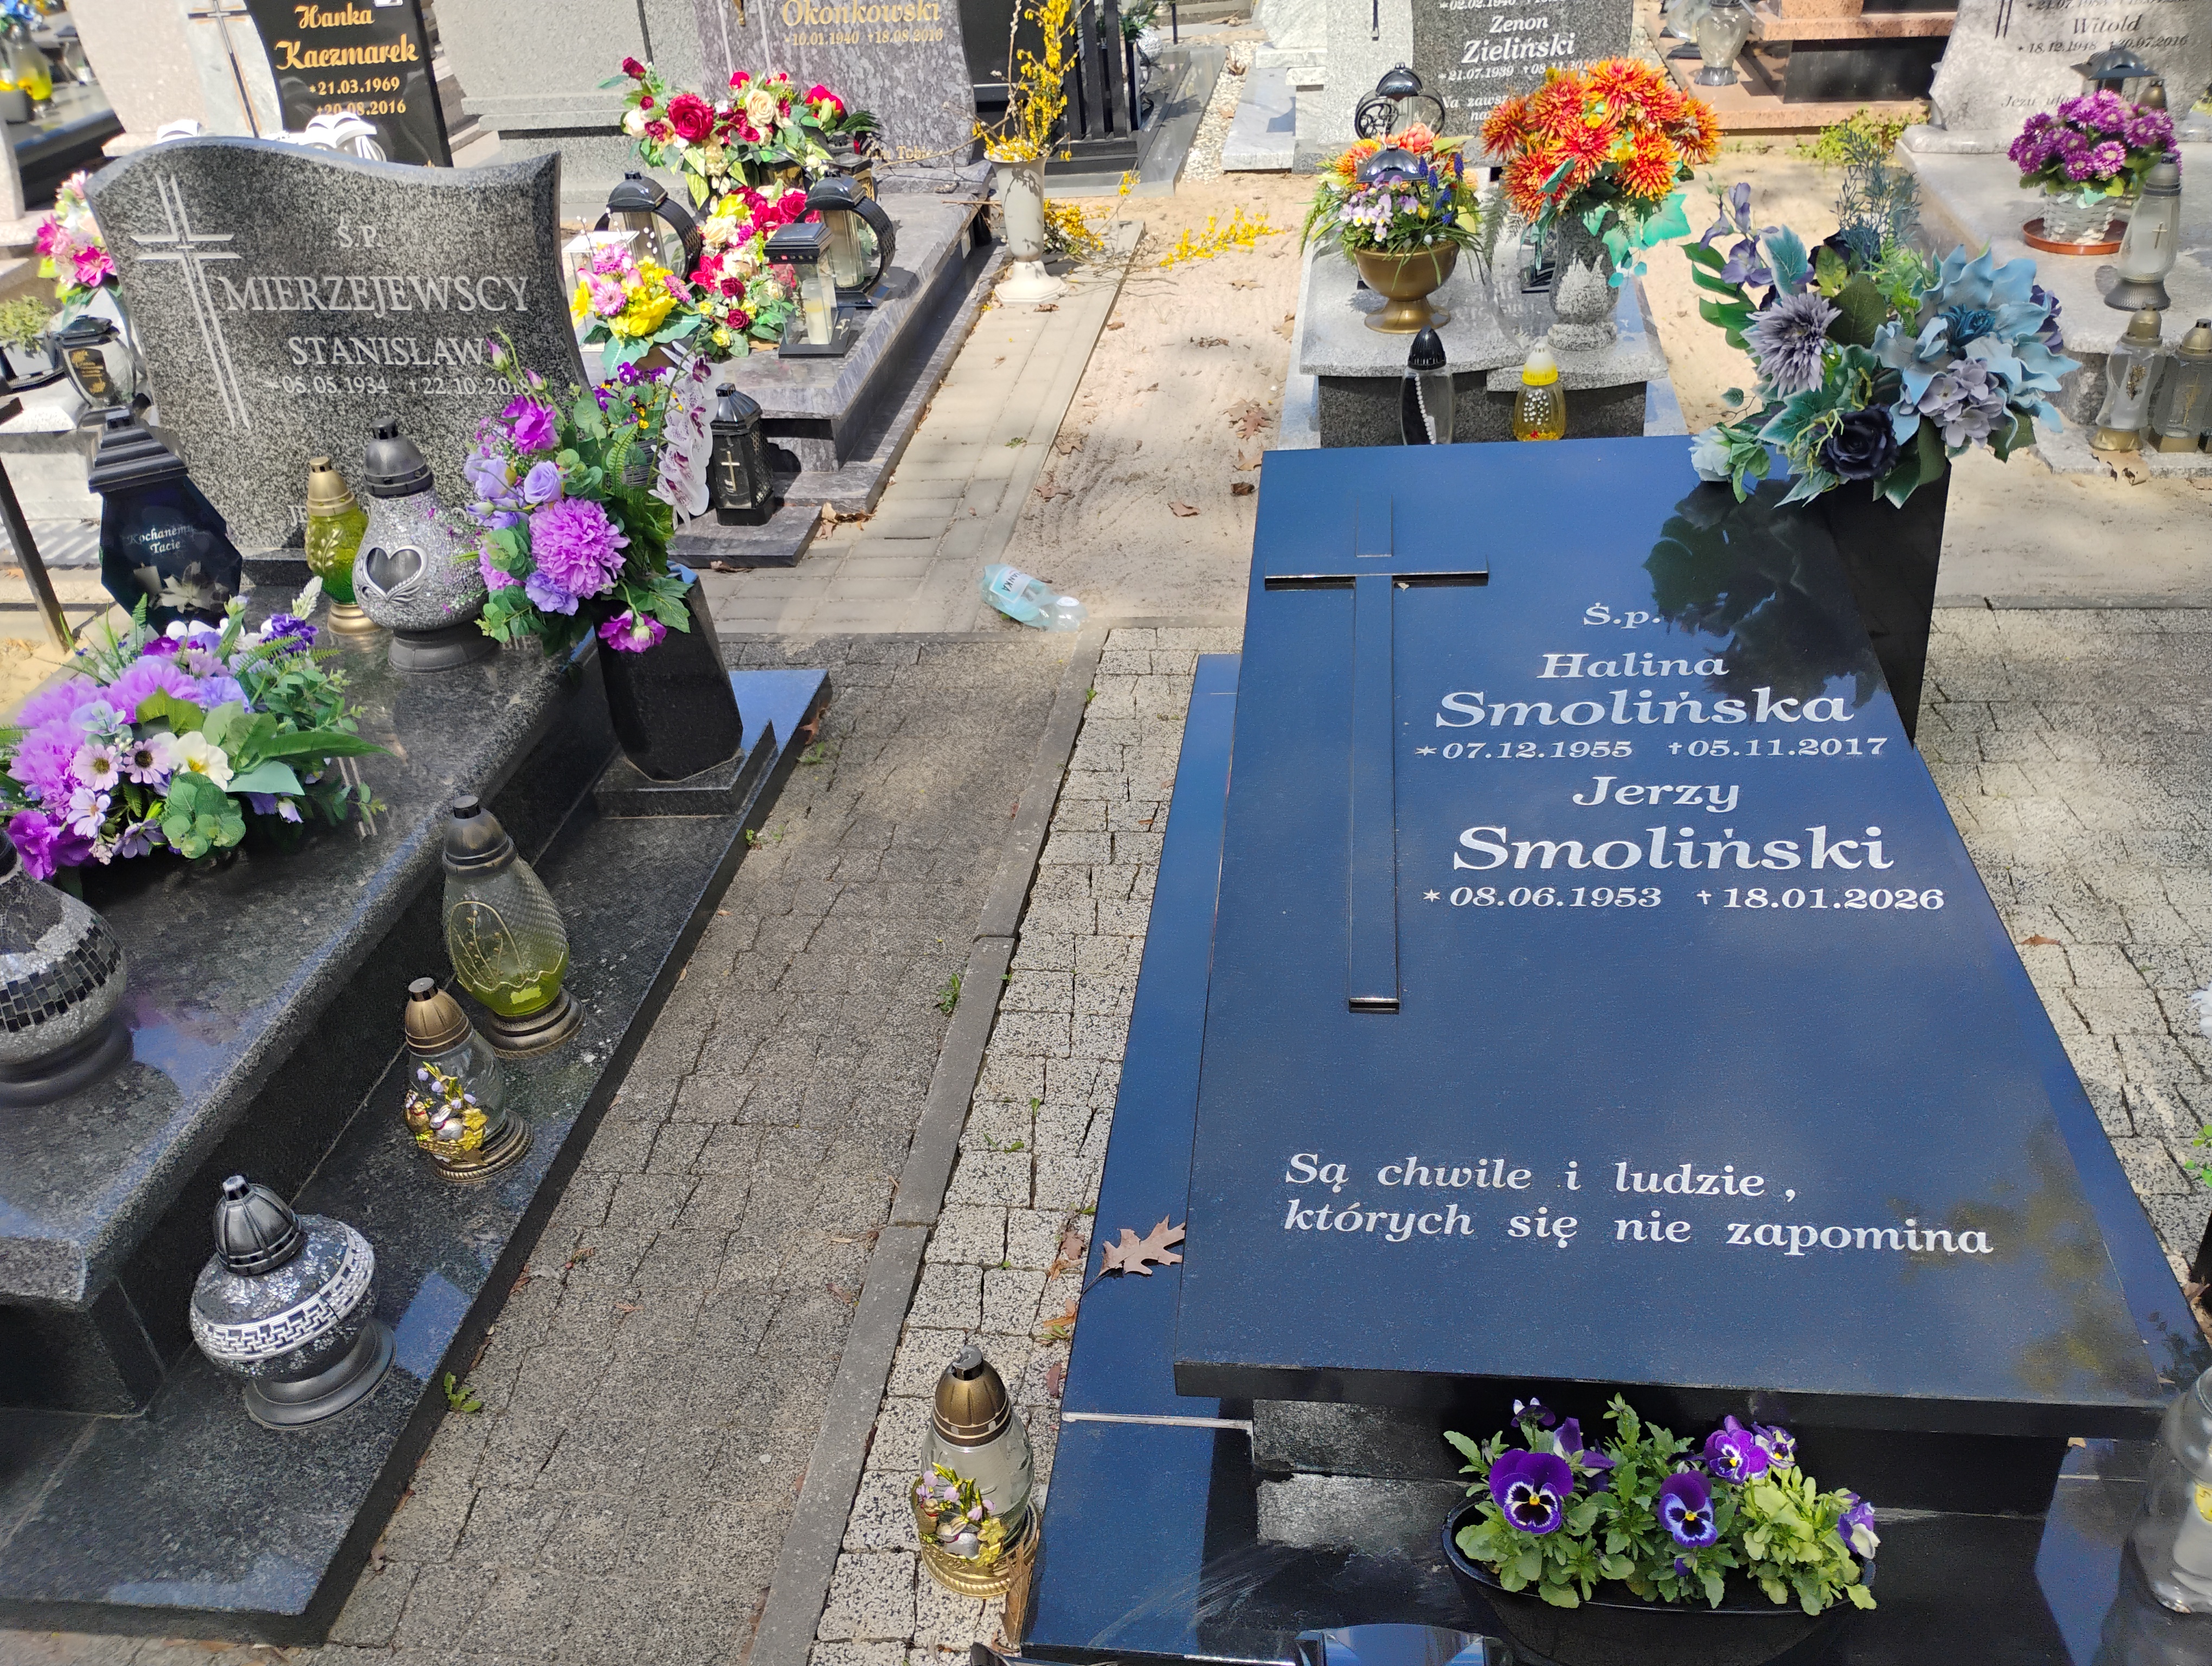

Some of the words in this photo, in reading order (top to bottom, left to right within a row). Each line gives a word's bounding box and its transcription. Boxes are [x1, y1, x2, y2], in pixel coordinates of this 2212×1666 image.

[294, 2, 375, 29] Hanka
[782, 0, 942, 26] Okonkowski
[1489, 15, 1548, 33] Zenon
[2073, 14, 2143, 35] Witold
[274, 34, 419, 70] Kaczmarek
[1461, 33, 1576, 63] Zieliński
[324, 98, 406, 116] 2008.2016
[1467, 94, 1513, 107] zawsz
[2001, 95, 2036, 107] Jezu
[217, 275, 529, 318] MIERZEJEWSCY
[288, 336, 486, 366] STANISŁAW
[150, 539, 181, 554] Tacie
[1535, 651, 1730, 680] Halina
[1435, 685, 1855, 728] Smolińska
[1572, 776, 1740, 813] Jerzy
[1453, 824, 1895, 870] Smoliński
[1285, 1152, 1349, 1194] Są
[1377, 1155, 1533, 1190] chwile
[1565, 1160, 1582, 1191] i
[1283, 1198, 1475, 1242] których
[1507, 1206, 1578, 1249] się
[1613, 1209, 1692, 1244] nie
[1725, 1218, 1995, 1257] zapomina
